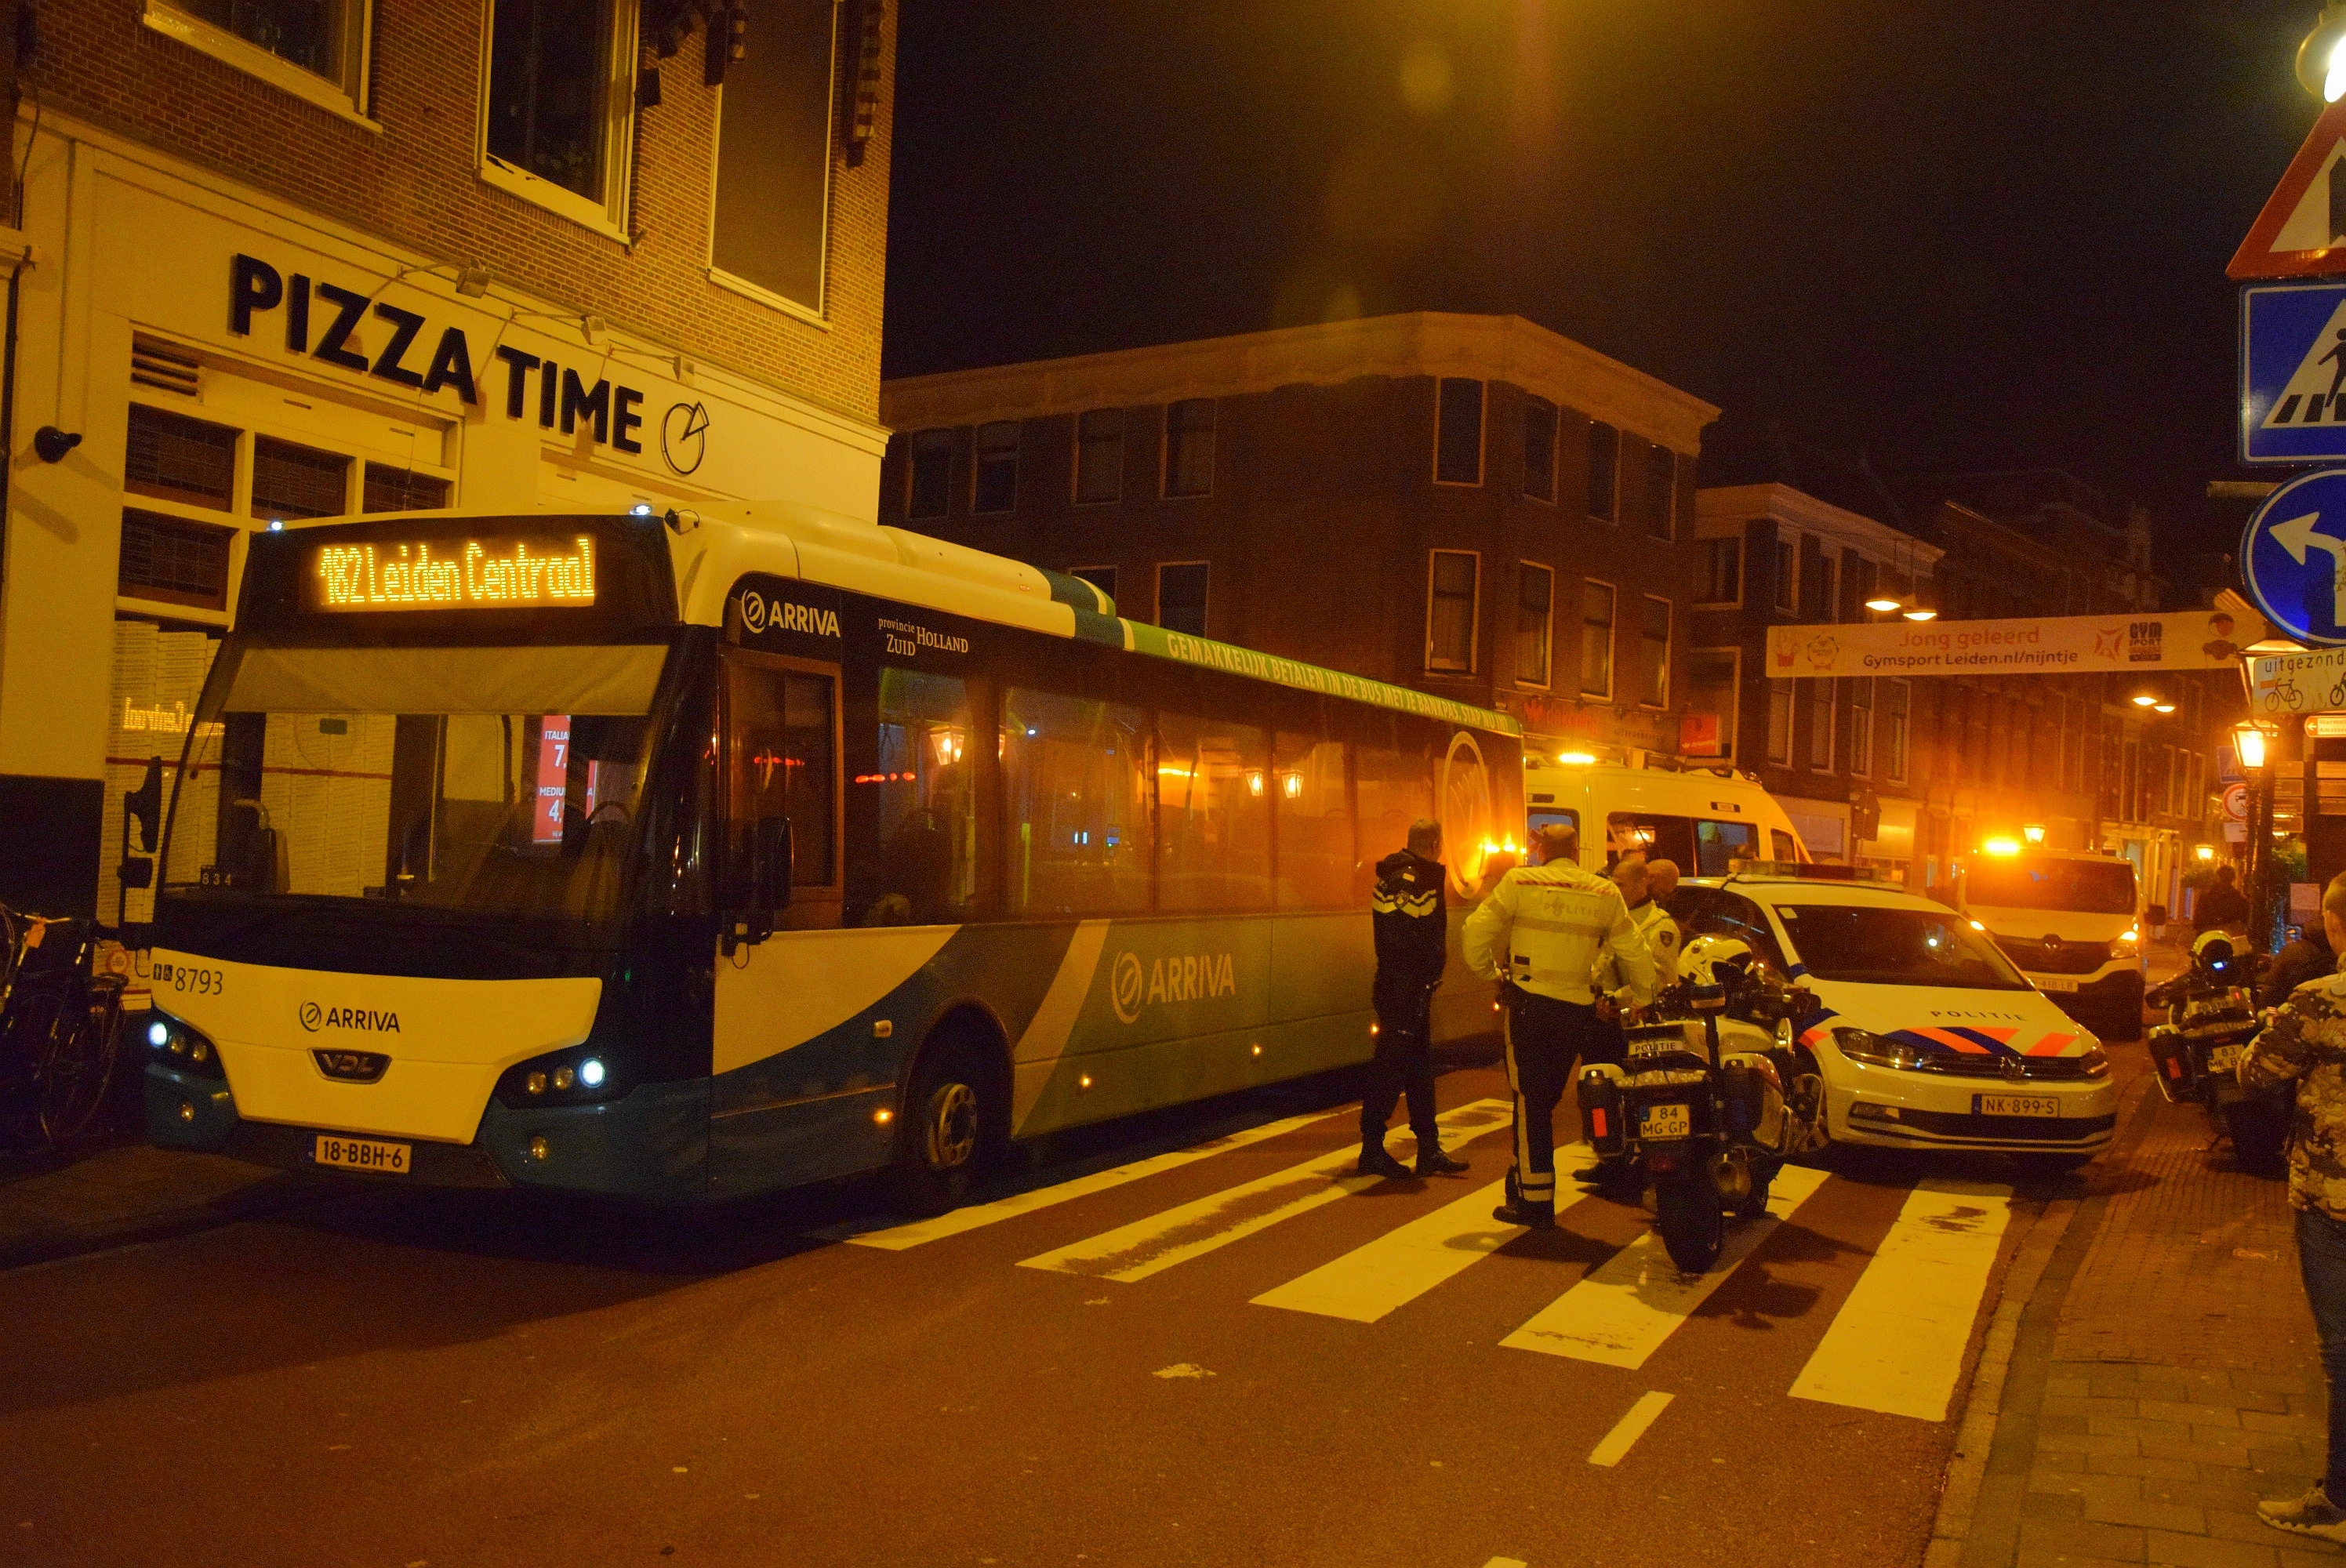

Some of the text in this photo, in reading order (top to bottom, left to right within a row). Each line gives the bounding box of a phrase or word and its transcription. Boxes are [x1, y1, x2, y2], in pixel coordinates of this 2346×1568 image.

[231, 252, 644, 454] PIZZA TIME
[320, 539, 595, 604] 182 Leiden Centraal
[768, 601, 841, 638] ARRIVA
[877, 618, 915, 634] provincie
[886, 626, 969, 656] ZUID HOLLAND
[1898, 626, 2039, 651] Jong geleerd
[1863, 650, 2079, 670] Gymsport Leiden.nl/nijntje
[1167, 633, 1269, 678] GEMAKKELIJK
[1269, 658, 1325, 691] BETALEN
[1326, 671, 1342, 694] IN
[1342, 675, 1359, 698] DE
[1359, 680, 1381, 702] BUS
[1382, 685, 1404, 707] MET
[1405, 690, 1416, 711] JE
[1462, 705, 1480, 725] STAP
[1480, 710, 1494, 728] NU
[554, 744, 567, 769] 7,
[549, 799, 565, 823] 4,
[175, 967, 223, 996] 8793
[1146, 953, 1236, 1005] ARRIVA
[325, 1007, 401, 1033] ARRIVA
[1930, 1010, 2028, 1022] POLITIE
[1635, 1043, 1676, 1053] POLITIE
[321, 1052, 376, 1073] VDL
[1659, 1107, 1679, 1119] 84
[1985, 1098, 2055, 1115] NK-899-S
[323, 1140, 403, 1169] 18-BBH-6
